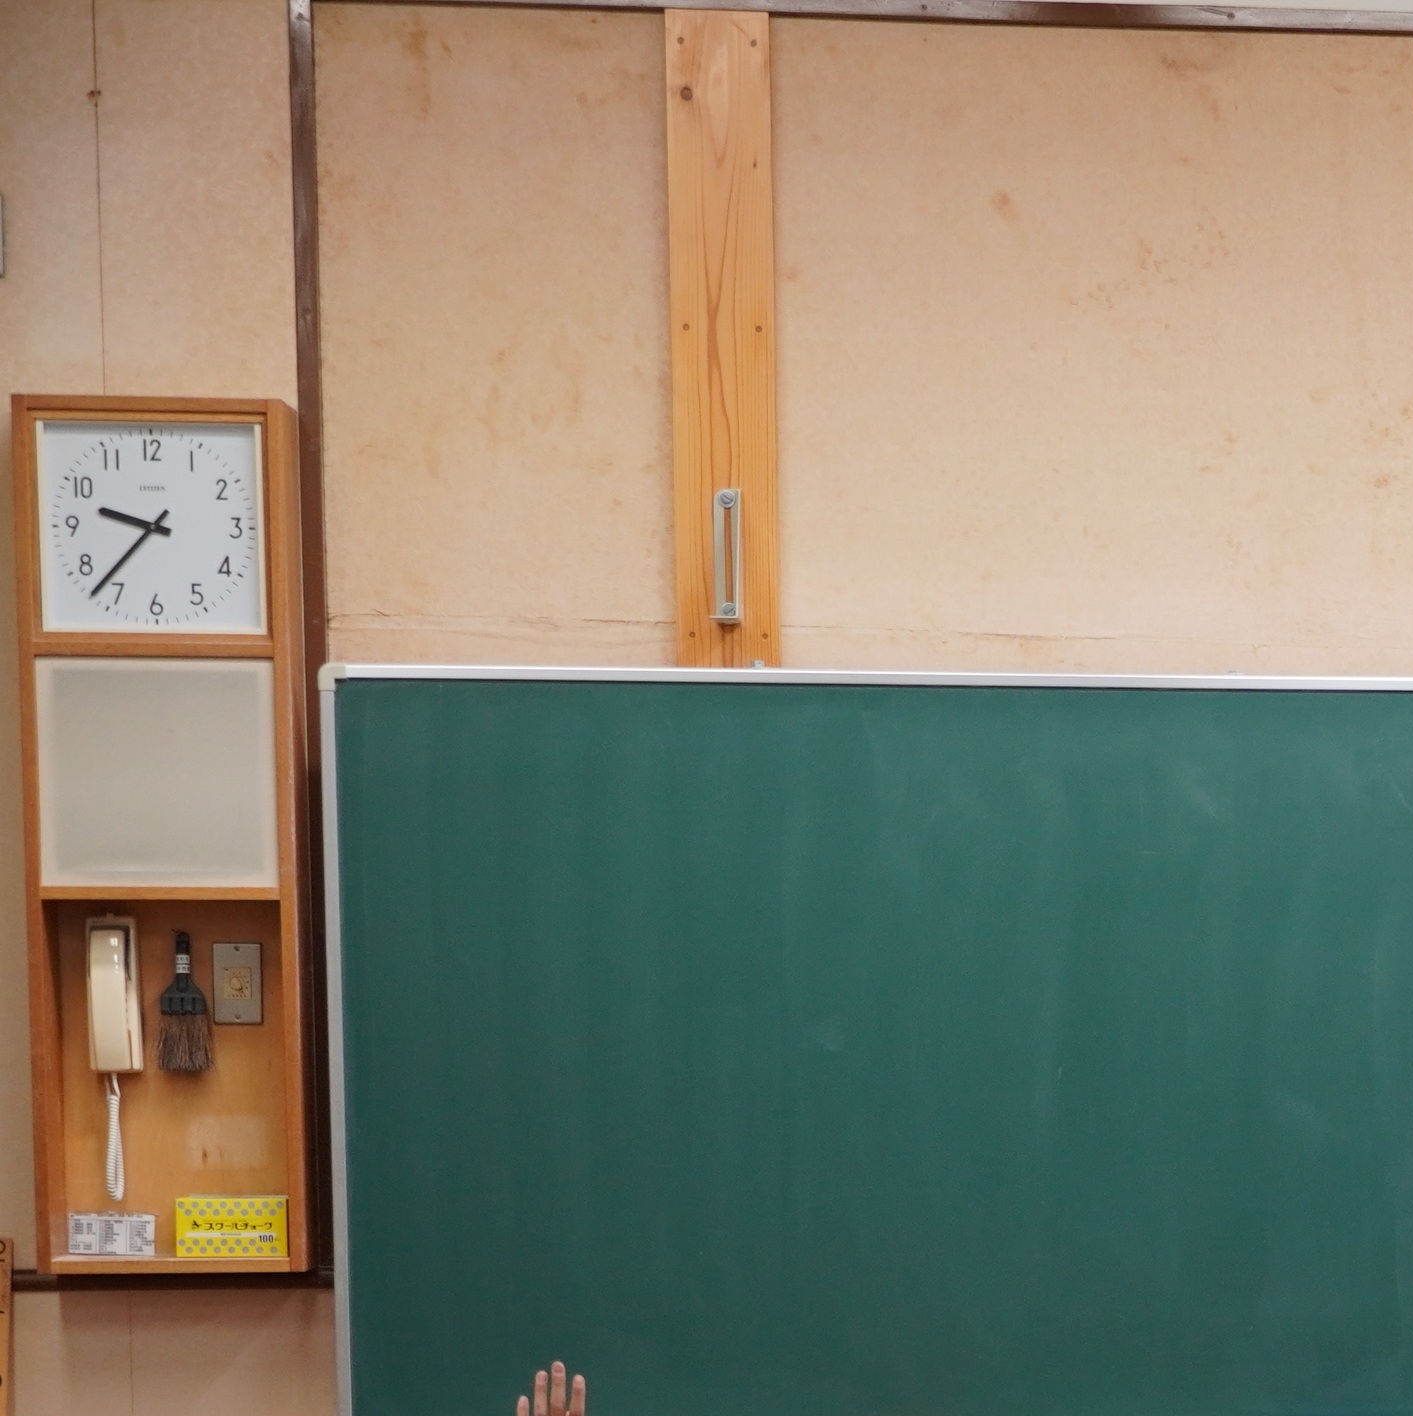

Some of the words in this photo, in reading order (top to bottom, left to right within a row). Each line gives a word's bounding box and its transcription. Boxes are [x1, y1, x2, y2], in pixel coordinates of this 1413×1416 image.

[103, 448, 120, 471] 11
[142, 439, 162, 461] 12
[73, 476, 93, 499] 10
[139, 484, 166, 492] CITIZEN
[215, 478, 229, 501] 2
[65, 515, 80, 537] 9
[229, 517, 243, 539] 3
[79, 553, 94, 576] 8
[217, 555, 232, 578] 4
[111, 583, 125, 606] 7
[149, 593, 164, 616] 6
[189, 583, 204, 606] 5
[203, 1222, 273, 1231] スクールチョーク
[258, 1234, 274, 1243] 100
